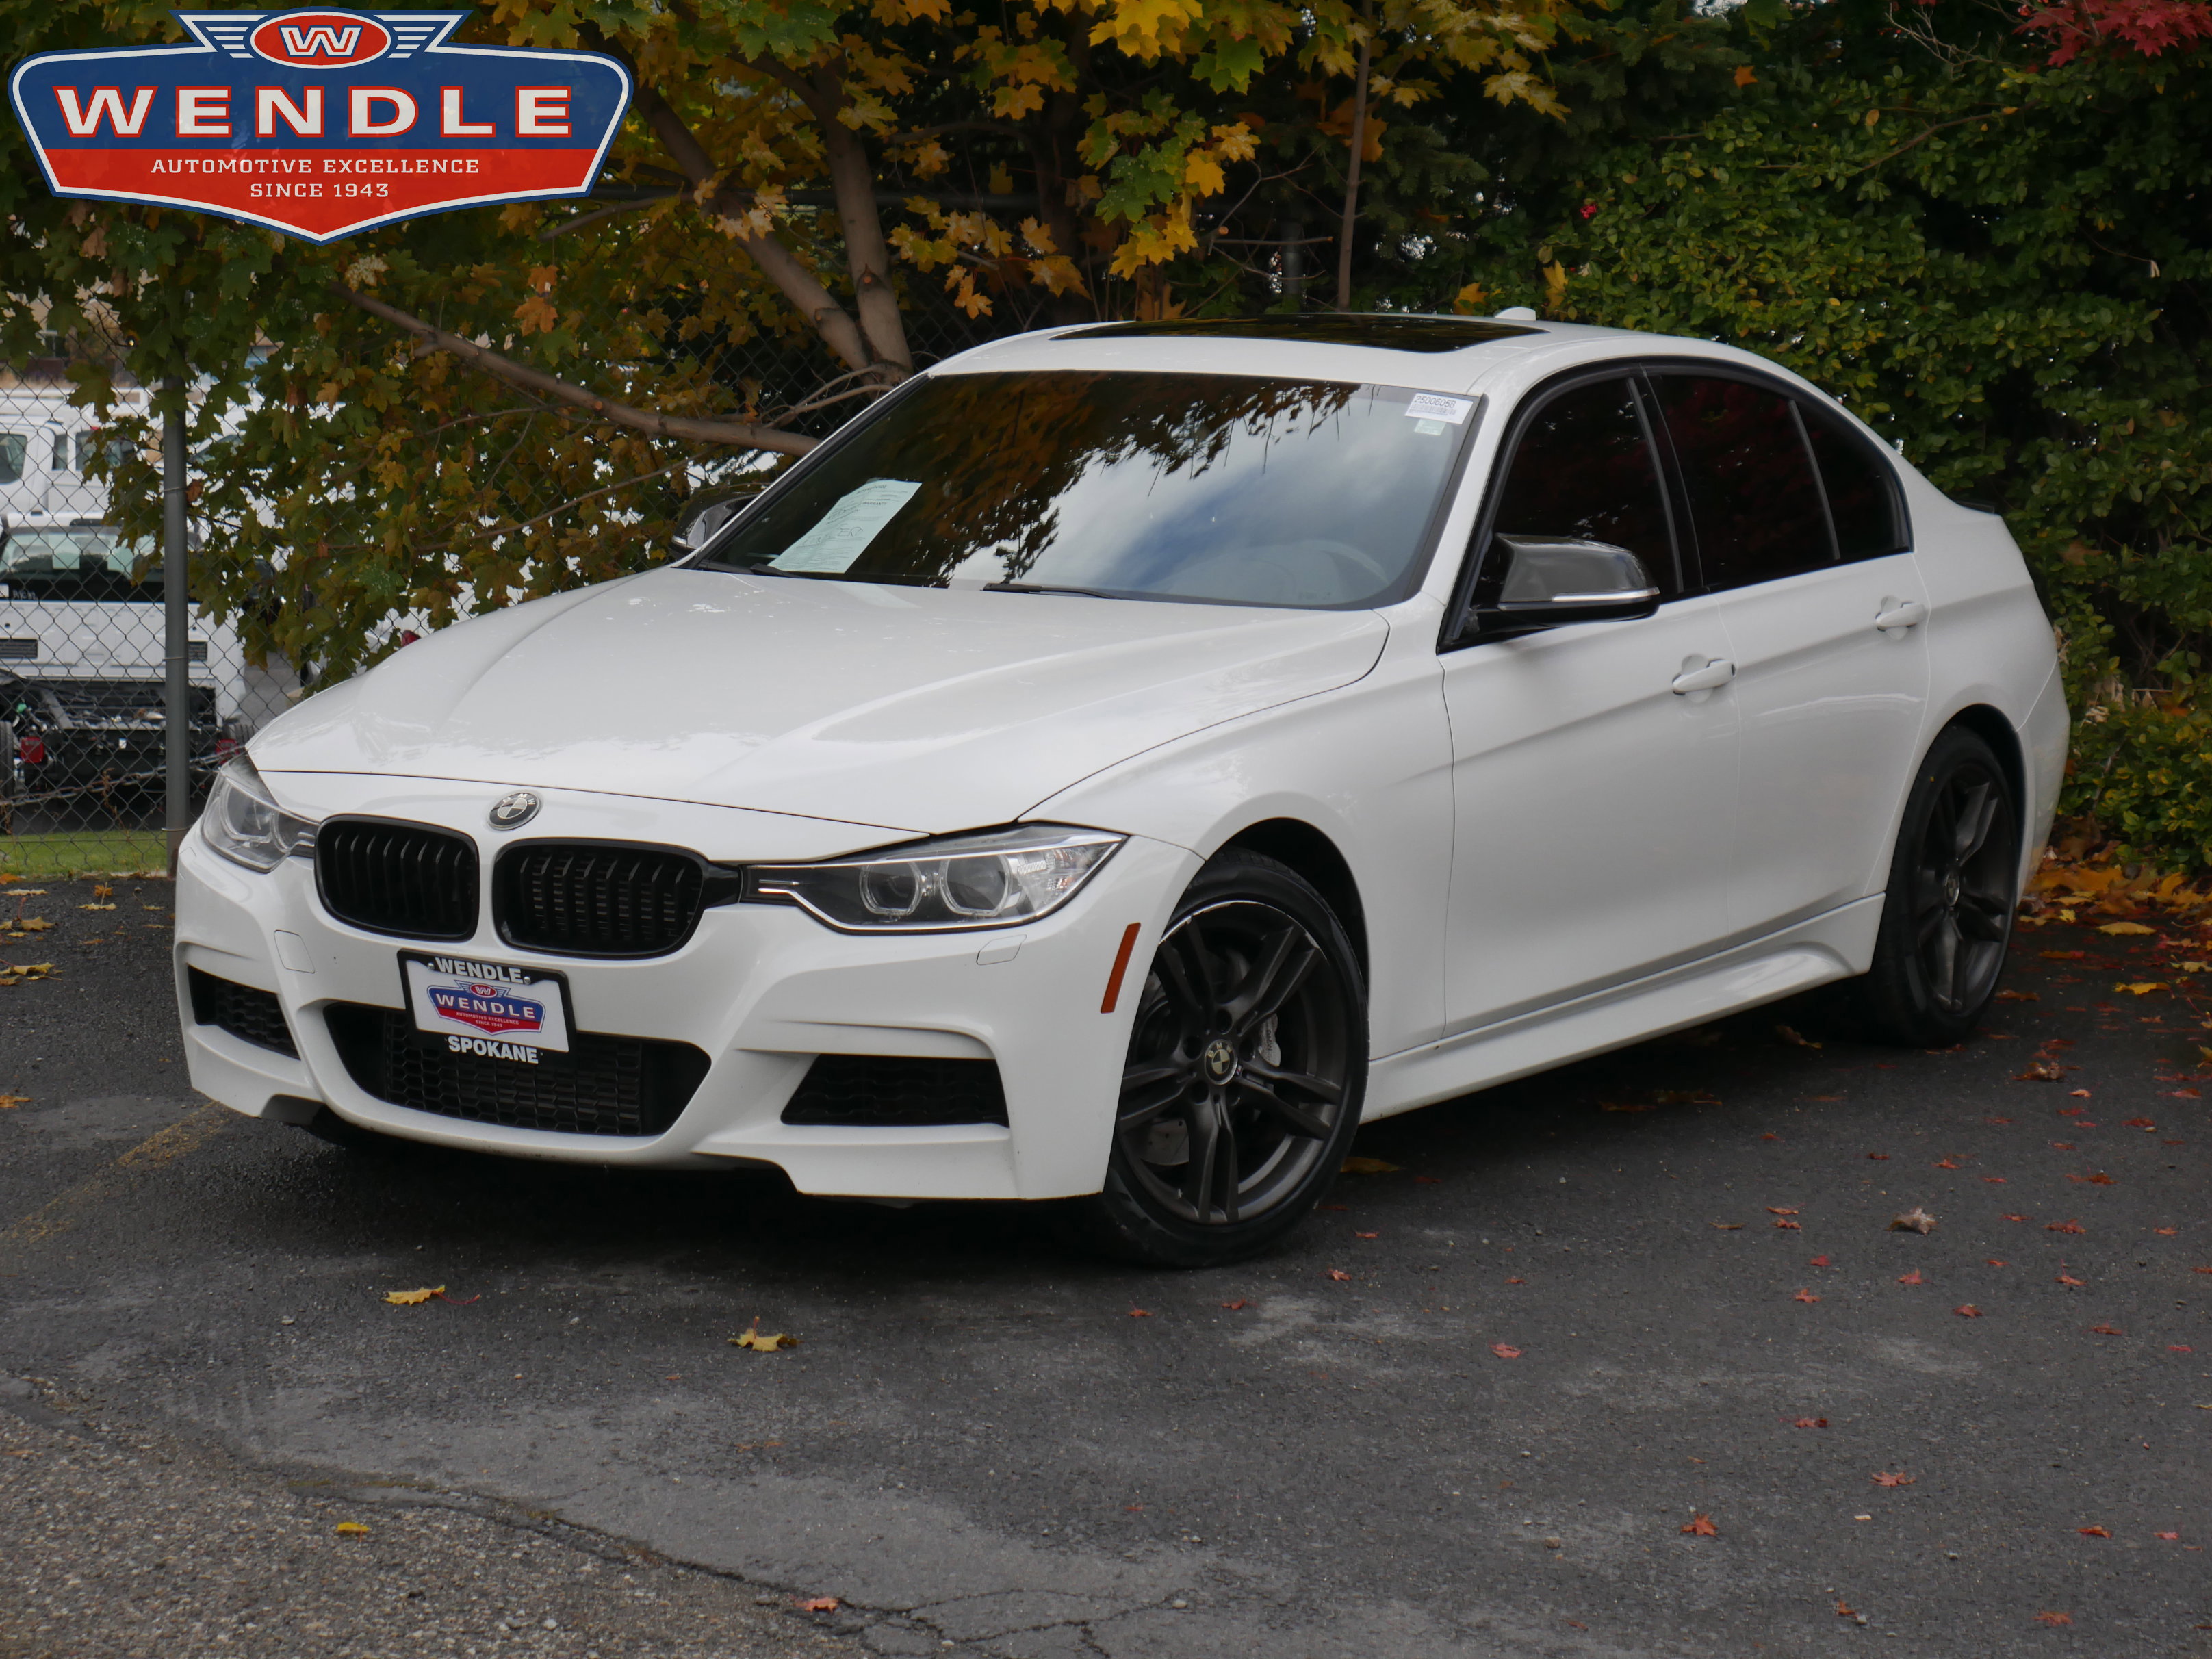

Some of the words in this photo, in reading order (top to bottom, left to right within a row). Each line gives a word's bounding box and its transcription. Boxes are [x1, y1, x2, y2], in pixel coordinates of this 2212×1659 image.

[435, 957, 525, 984] WENDLE
[435, 993, 536, 1018] WENDLE
[456, 1012, 487, 1020] AUTOMOTIVE
[488, 1016, 519, 1025] EXCELLENCE
[448, 1036, 539, 1064] SPOKANE
[1207, 1042, 1232, 1059] BMW
